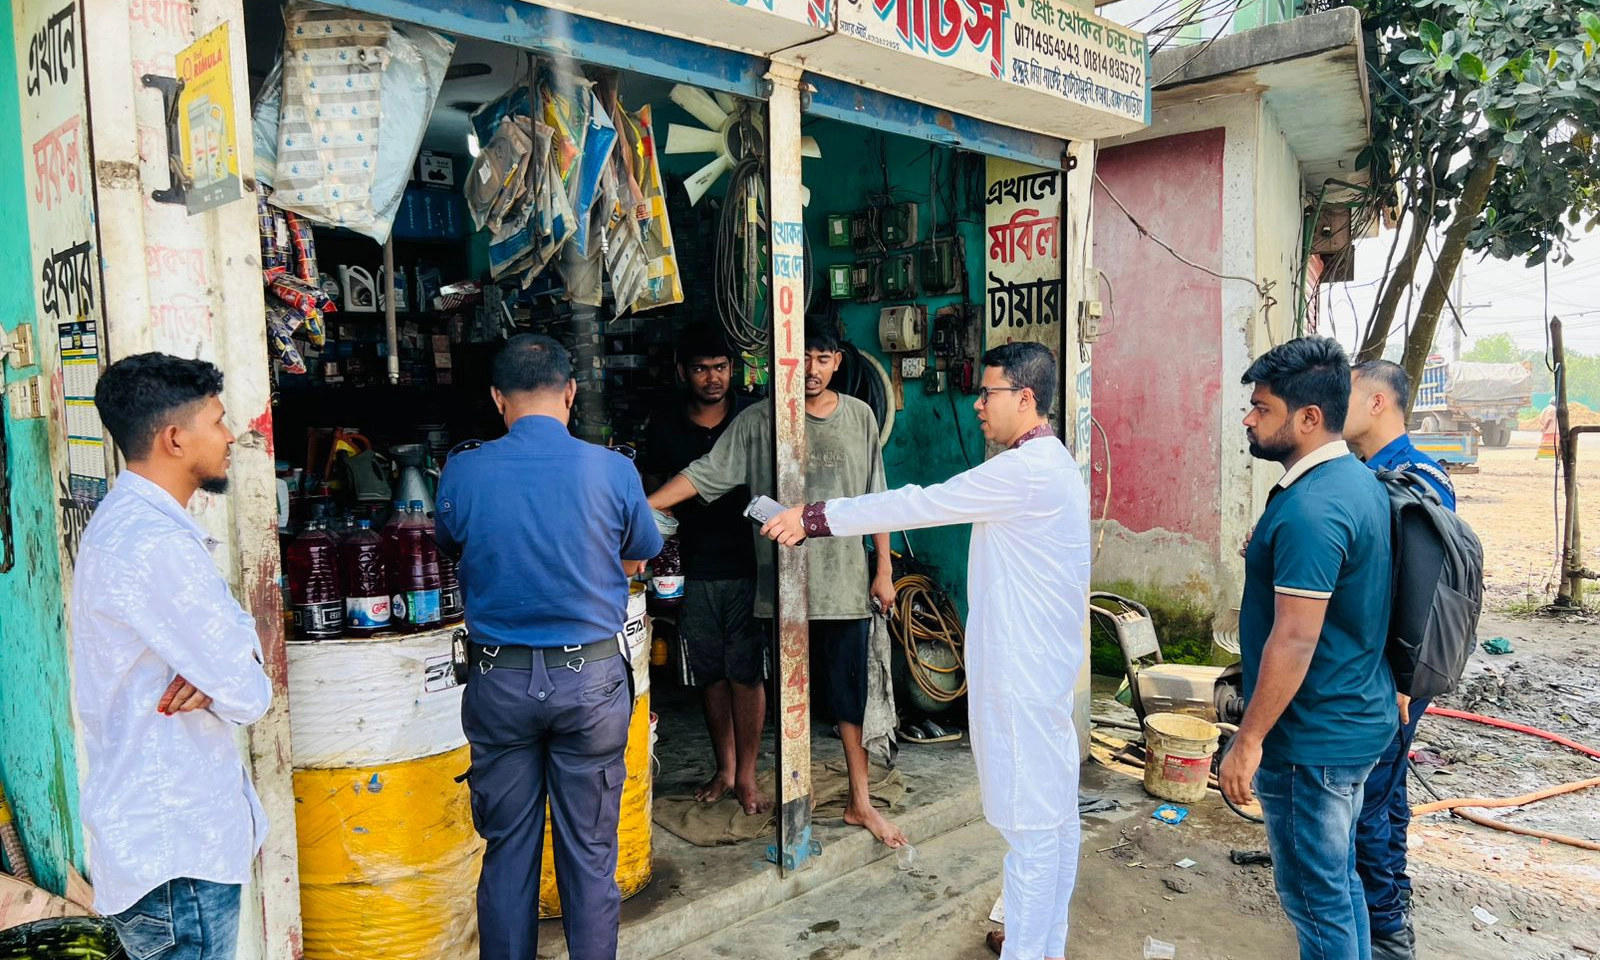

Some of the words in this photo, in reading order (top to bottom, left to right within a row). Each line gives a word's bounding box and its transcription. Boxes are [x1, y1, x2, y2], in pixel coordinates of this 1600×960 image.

[27, 2, 76, 97] এখানে
[1057, 8, 1103, 45] খোকন
[1106, 28, 1128, 55] চন্দ্র
[1129, 36, 1143, 64] দে
[986, 170, 1060, 205] এখানে
[988, 208, 1059, 263] মবিল
[42, 240, 94, 319] প্রকার
[988, 271, 1062, 328] টায়ার
